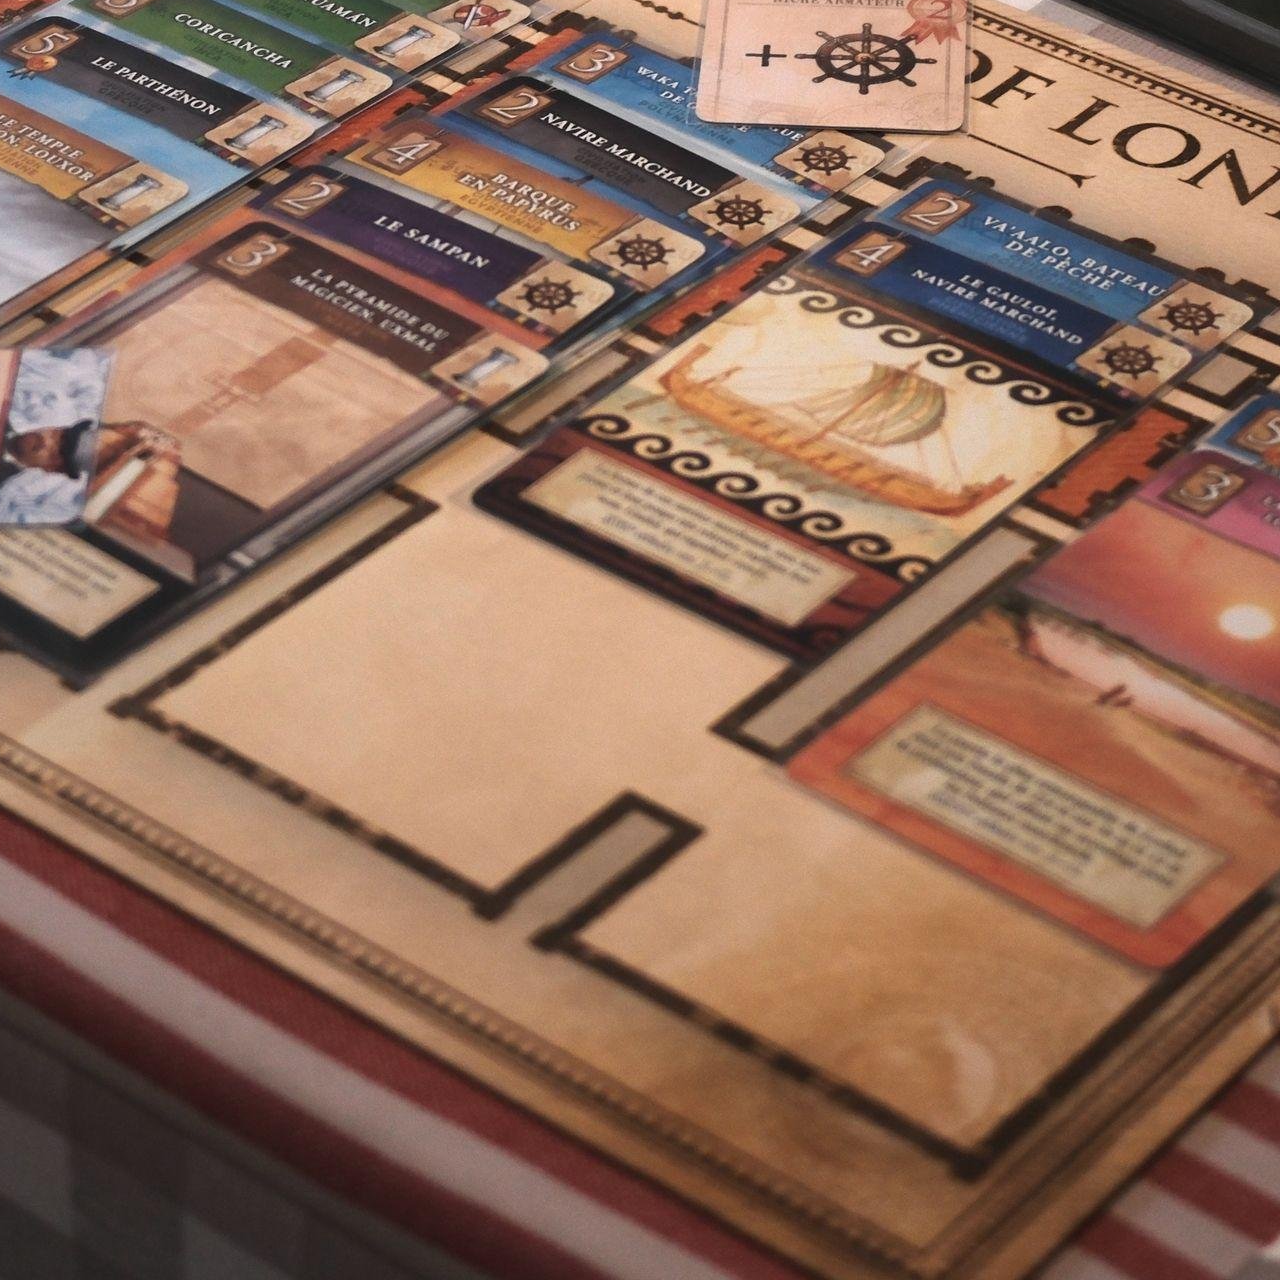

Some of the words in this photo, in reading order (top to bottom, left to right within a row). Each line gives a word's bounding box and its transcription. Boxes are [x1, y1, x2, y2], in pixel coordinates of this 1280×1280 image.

[20, 31, 71, 56] 5
[173, 12, 294, 70] CORICANCHA
[569, 48, 617, 73] 3
[636, 65, 680, 90] WAKA
[90, 55, 115, 74] LE
[114, 66, 222, 118] PARTHÉNON
[489, 91, 541, 119] 2
[660, 89, 684, 104] DE
[17, 123, 85, 160] TEMPLE
[386, 141, 431, 165] 4
[540, 111, 608, 149] NAVIRE
[606, 140, 713, 201] MARCHAND
[24, 139, 96, 184] LOUXOR
[282, 181, 332, 212] 2
[458, 173, 488, 195] EN
[489, 188, 582, 234] PAPYRUS
[491, 173, 578, 215] BARQUE
[908, 197, 959, 227] 2
[227, 240, 281, 268] 3
[374, 214, 406, 233] LE
[408, 225, 492, 270] SAMPAN
[849, 243, 893, 268] 4
[959, 273, 986, 290] LE
[1004, 239, 1037, 260] DE
[1038, 253, 1116, 293] PÊCHE
[1075, 257, 1168, 299] BATEAU
[309, 267, 332, 282] LA
[334, 278, 419, 330] PYRAMIDE
[420, 320, 451, 342] DU
[911, 268, 977, 300] NAVIRE
[979, 294, 1084, 347] MARCHAND
